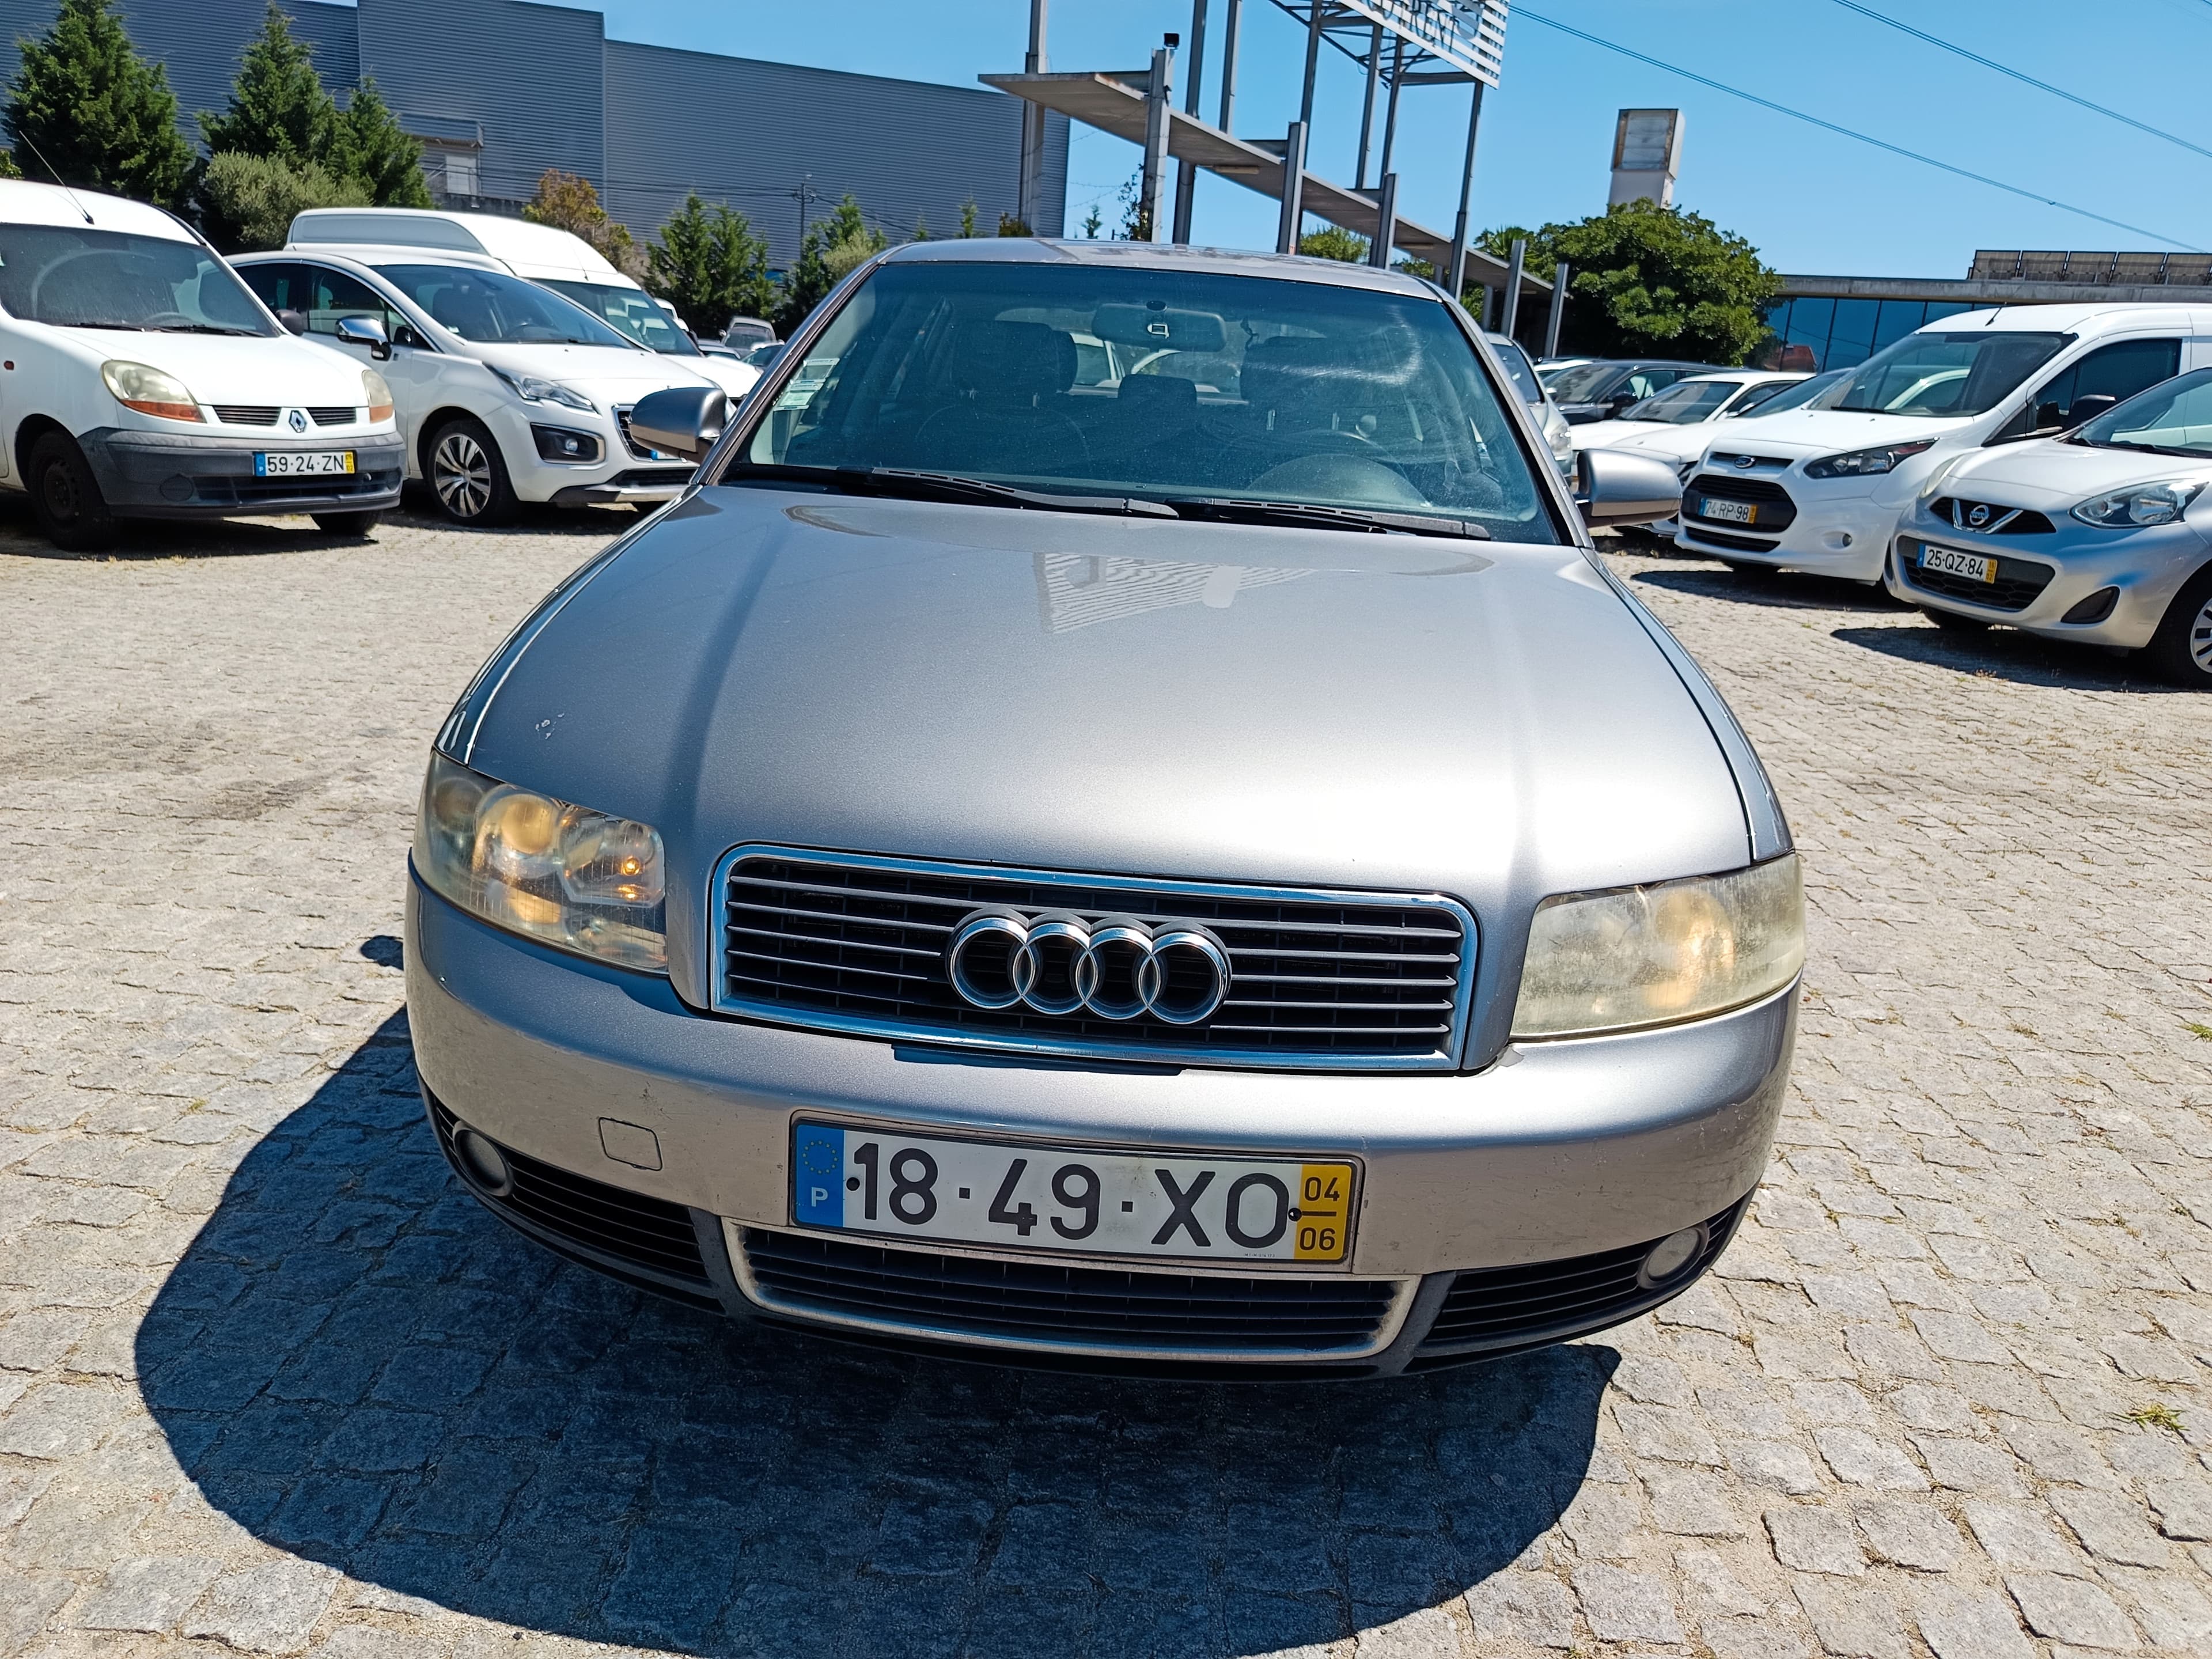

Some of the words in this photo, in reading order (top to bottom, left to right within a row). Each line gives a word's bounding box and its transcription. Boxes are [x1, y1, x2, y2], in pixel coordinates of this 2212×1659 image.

[810, 1187, 828, 1207] P
[1304, 1177, 1340, 1202] 04
[1299, 1228, 1336, 1251] 06
